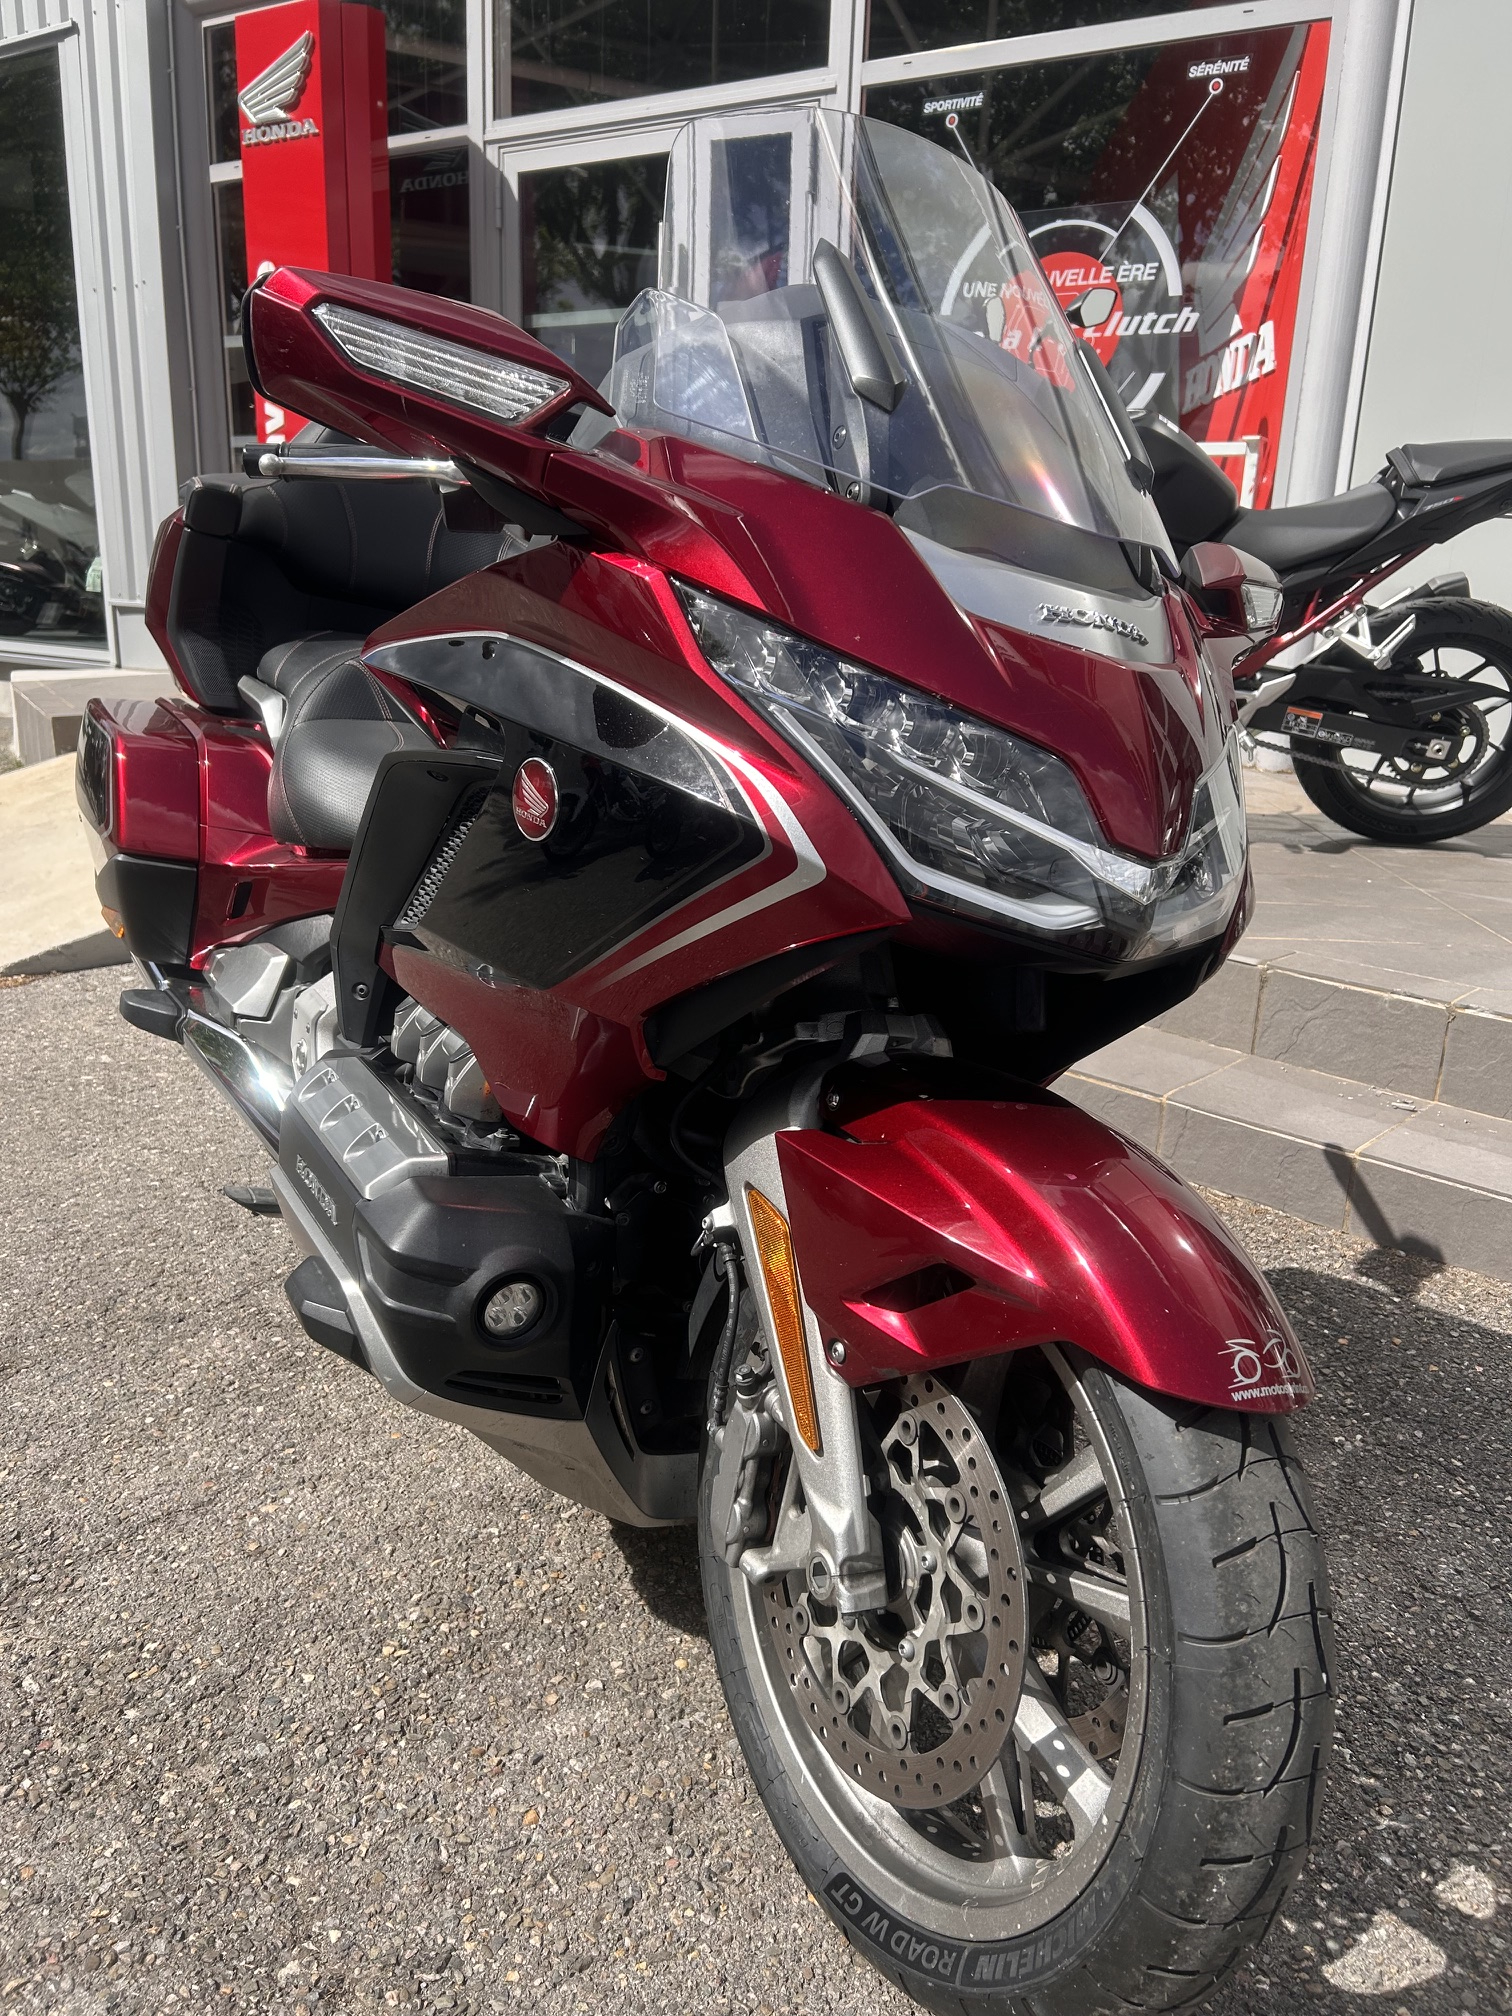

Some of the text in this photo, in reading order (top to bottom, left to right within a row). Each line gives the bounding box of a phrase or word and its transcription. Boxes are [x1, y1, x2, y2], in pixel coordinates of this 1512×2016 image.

[1188, 56, 1249, 78] SÉRÉNITÉ
[923, 92, 984, 114] SPORTIVITÉ
[242, 118, 319, 146] HONDA
[963, 281, 998, 299] UNE
[1116, 260, 1159, 283] ÈRE
[1038, 602, 1149, 647] HONDA
[515, 805, 548, 829] HONDA
[830, 1882, 957, 1977] ROAD W GT
[973, 1891, 1098, 1981] MICHELIN
